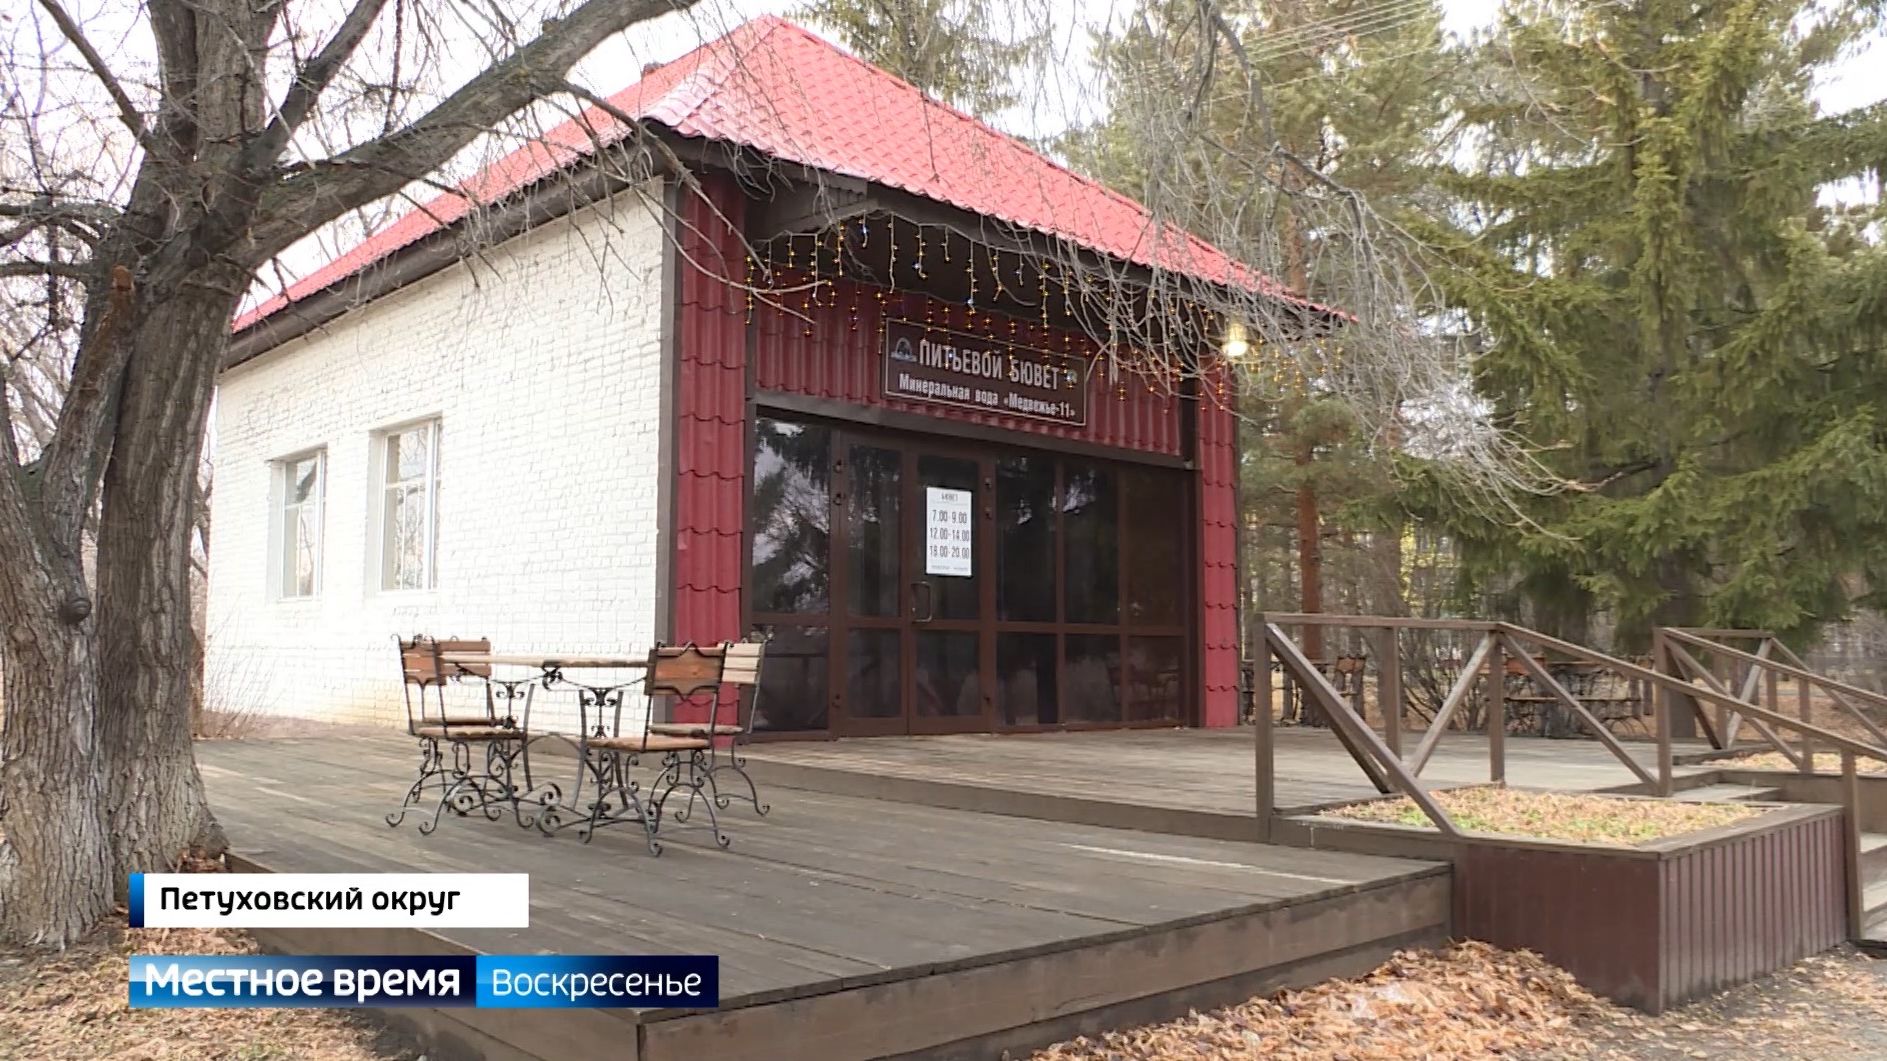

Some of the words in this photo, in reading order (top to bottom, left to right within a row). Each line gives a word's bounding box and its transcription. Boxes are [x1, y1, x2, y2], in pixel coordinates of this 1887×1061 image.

[919, 338, 1002, 380] ПИТЬЕВОЙ
[1010, 358, 1060, 390] БЮВЕТ
[899, 373, 970, 400] Минеральная
[975, 391, 999, 405] вода
[1003, 393, 1076, 418] «Медвежье-11»
